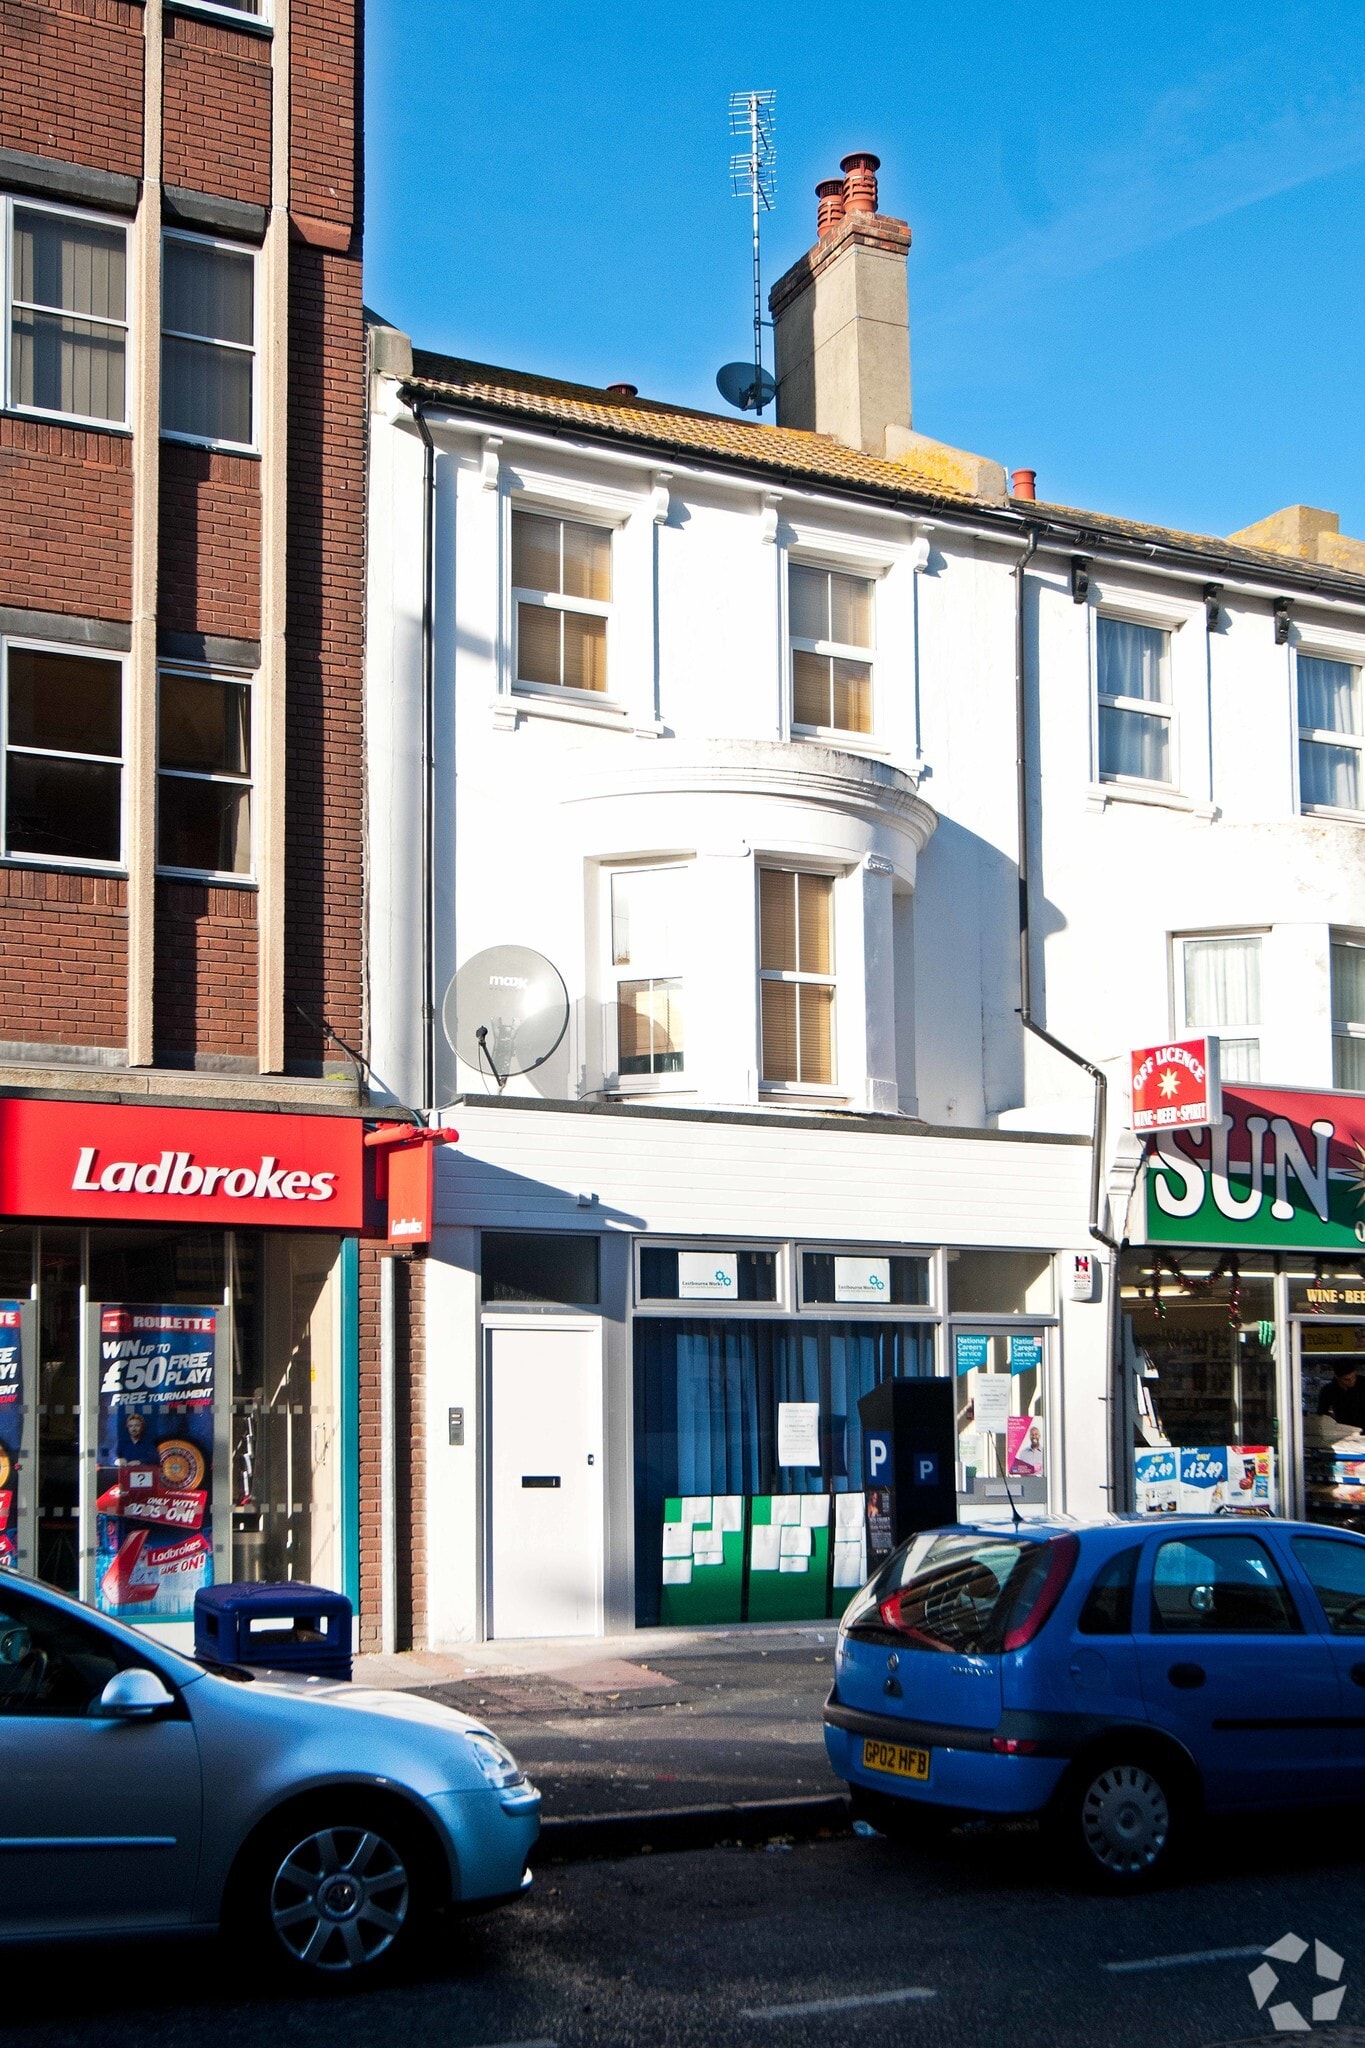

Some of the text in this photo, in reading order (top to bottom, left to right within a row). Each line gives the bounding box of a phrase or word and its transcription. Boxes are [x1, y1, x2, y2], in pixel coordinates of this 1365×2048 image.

[1133, 1046, 1205, 1090] OFF LICENCE
[1134, 1102, 1206, 1127] WINE BEER SPIRIT
[71, 1146, 336, 1202] Ladbrokes
[1155, 1114, 1335, 1222] SUN
[1306, 1288, 1338, 1304] WINE
[133, 1315, 212, 1331] ROULETTE
[102, 1339, 171, 1360] WIN UP TO
[957, 1336, 986, 1345] National
[168, 1352, 212, 1370] FREE
[101, 1355, 168, 1393] £50
[165, 1367, 212, 1387] PLAY!
[111, 1387, 213, 1407] FREE TOURNAMENT
[870, 1439, 887, 1477] P
[919, 1460, 934, 1480] P
[1183, 1461, 1223, 1478] £13.49
[147, 1496, 199, 1508] ONLY WITH
[151, 1539, 202, 1563] Ladbrokes
[180, 1552, 206, 1573] ON!
[865, 1741, 928, 1775] GP02 HFB
